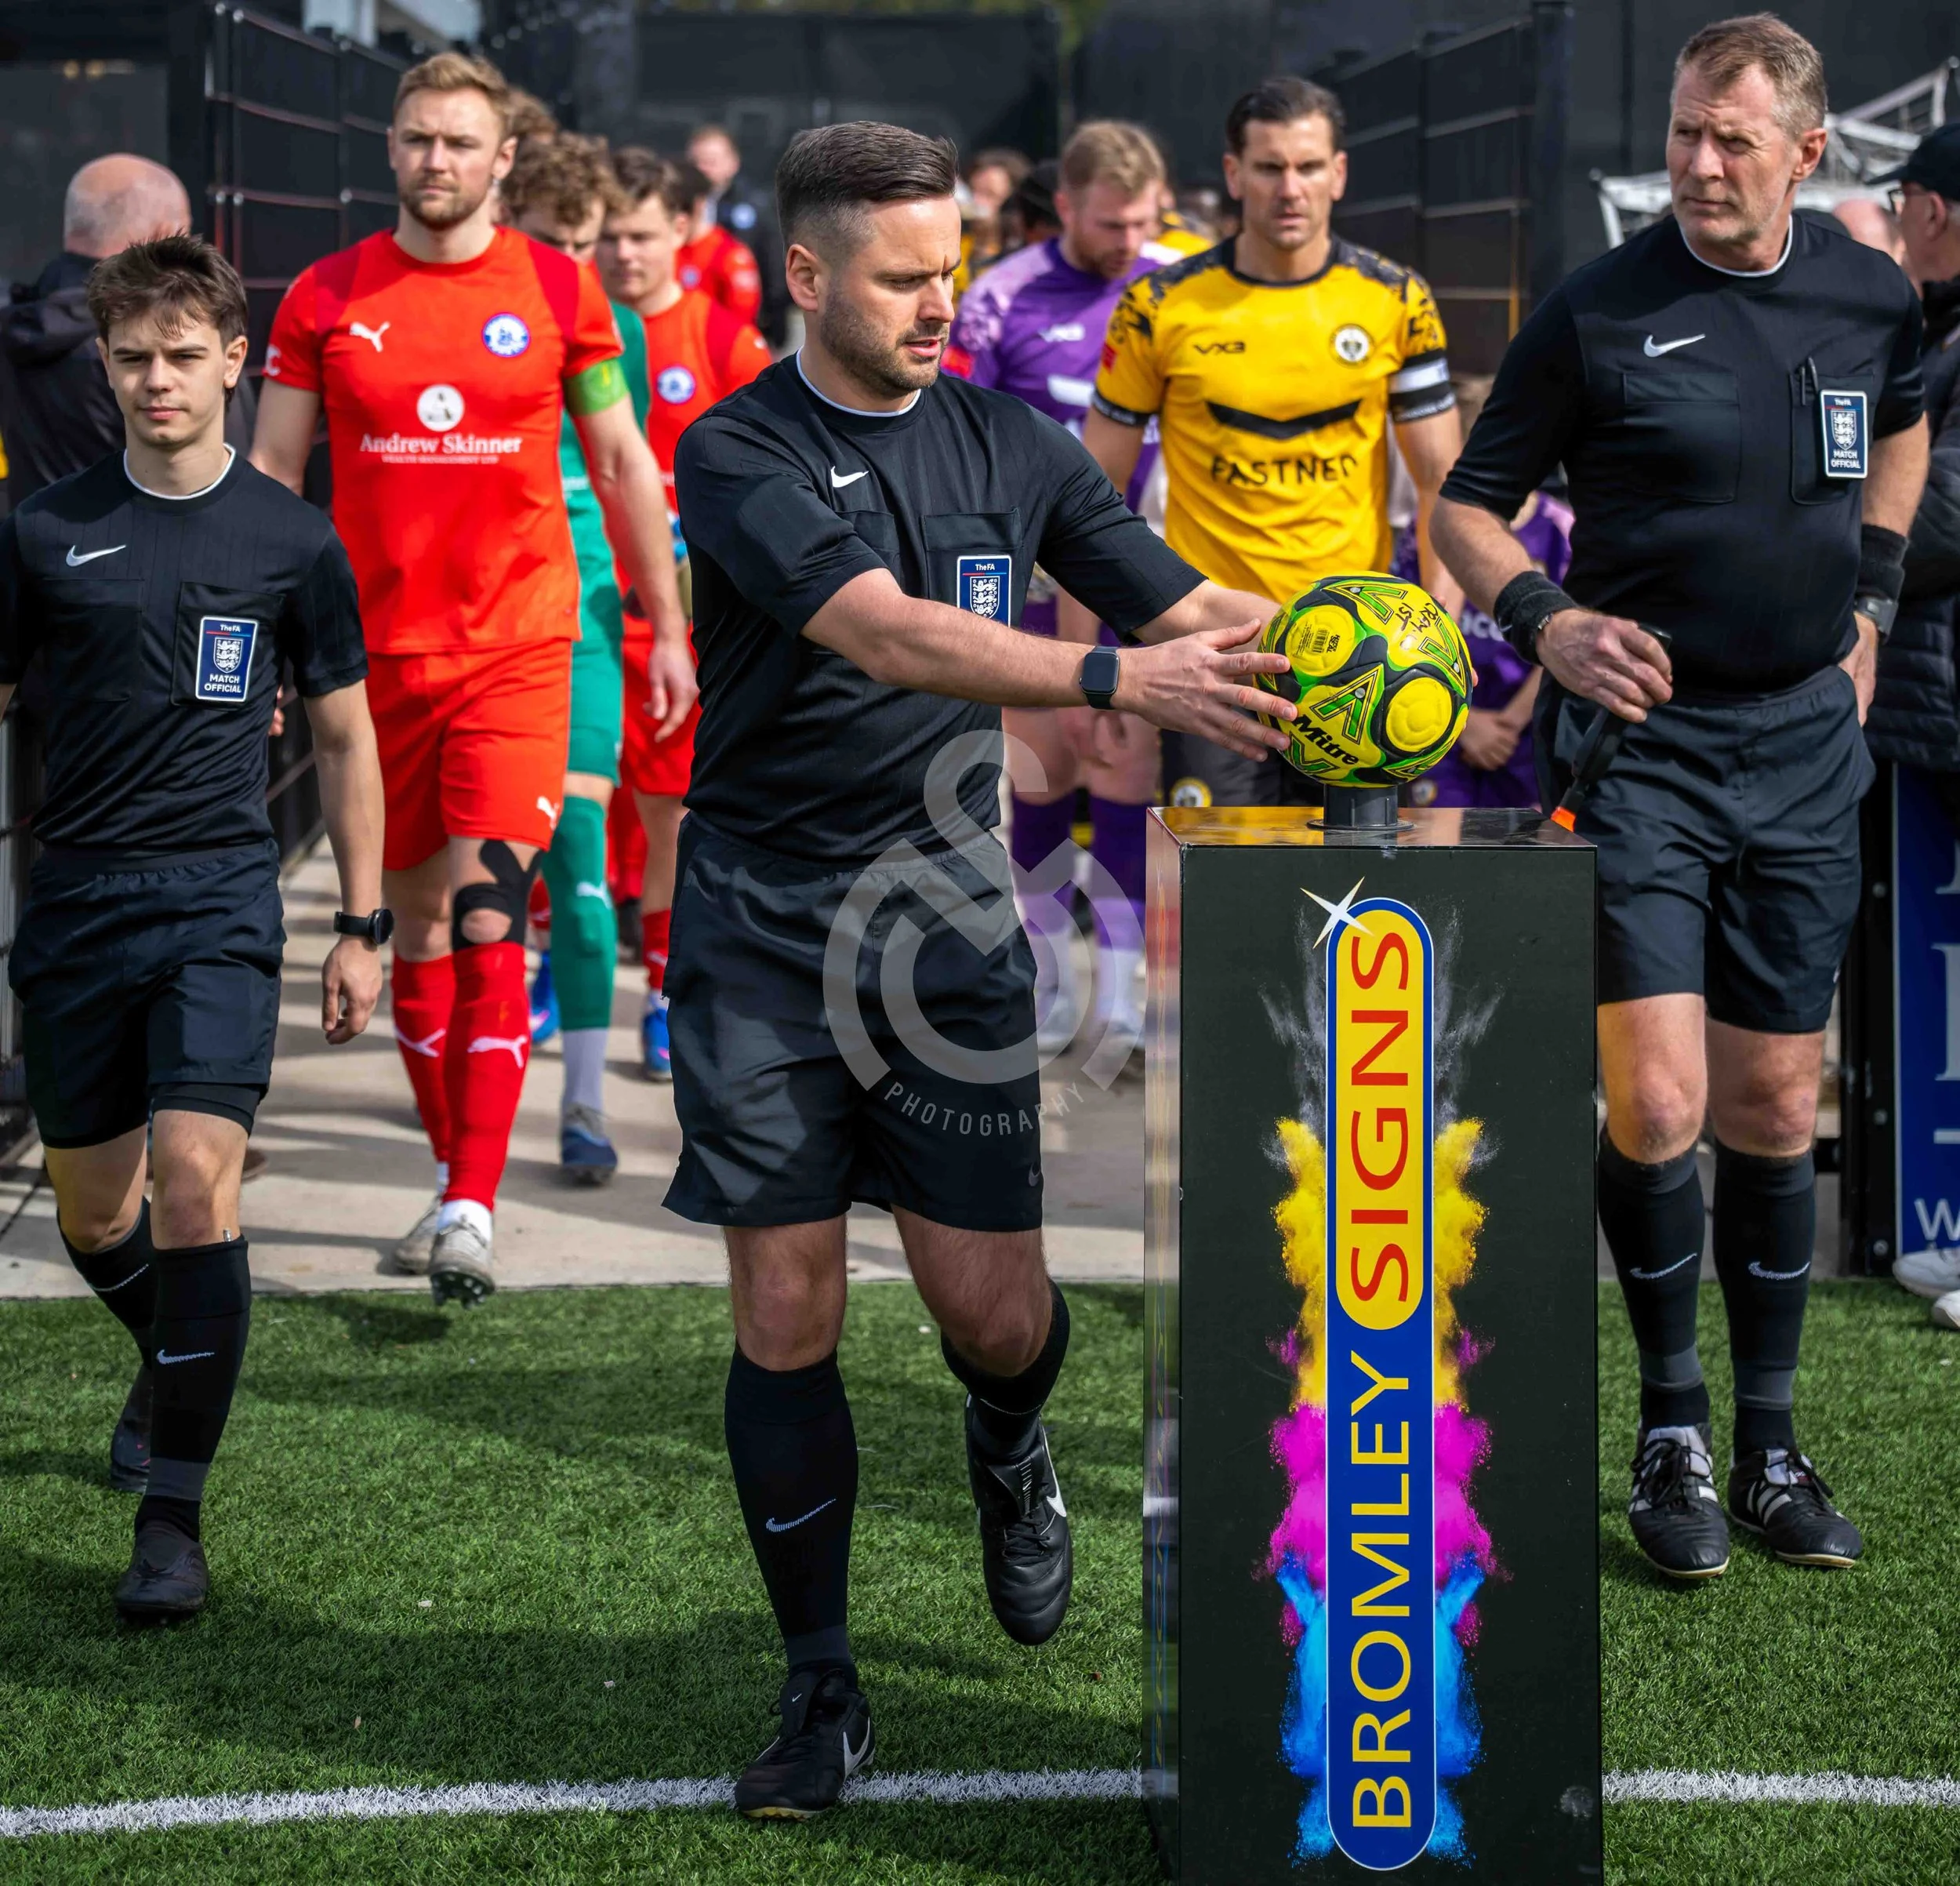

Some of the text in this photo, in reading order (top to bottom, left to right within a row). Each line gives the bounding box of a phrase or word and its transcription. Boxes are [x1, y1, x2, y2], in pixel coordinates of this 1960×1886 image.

[359, 432, 523, 454] Andrew Skinner
[1833, 449, 1857, 460] MATCH
[1831, 459, 1861, 469] OFFICIAL
[209, 674, 240, 684] MATCH
[204, 683, 241, 693] OFFICIAL
[1294, 714, 1359, 765] Mitre
[1350, 932, 1411, 1827] BROMLEY SIGNS
